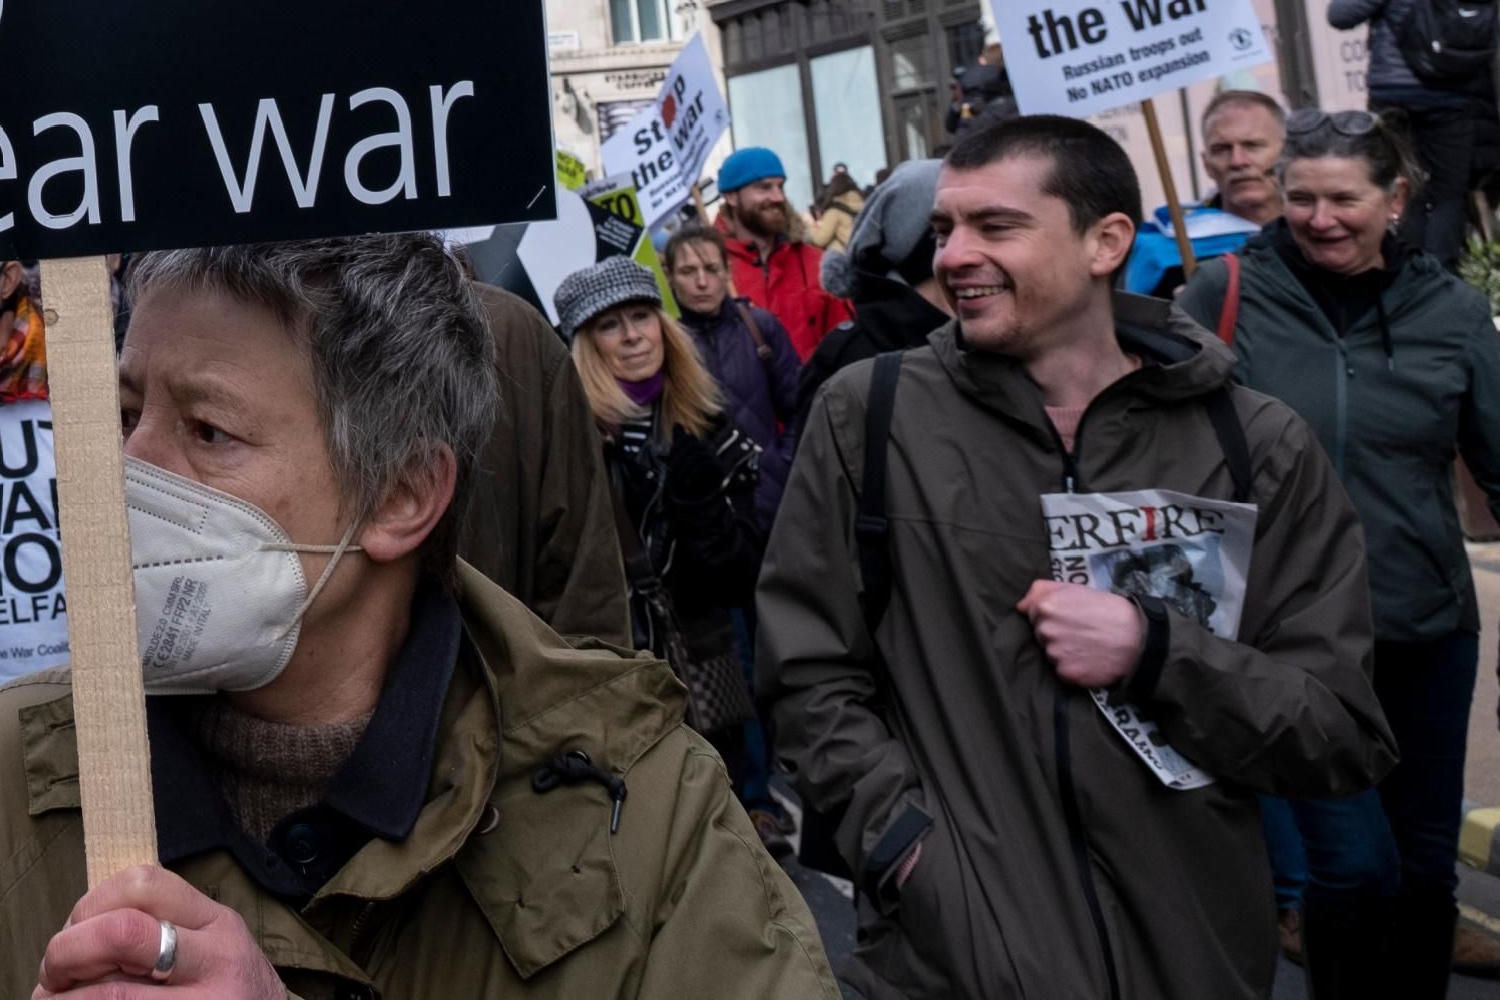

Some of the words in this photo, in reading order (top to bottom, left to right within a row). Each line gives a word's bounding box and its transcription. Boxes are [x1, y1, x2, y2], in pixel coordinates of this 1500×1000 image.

[1026, 7, 1108, 59] the
[1062, 52, 1126, 82] Russian
[1129, 34, 1176, 62] troops
[1180, 27, 1204, 46] out
[1067, 85, 1088, 102] No
[1091, 74, 1134, 97] NATO
[1138, 50, 1211, 83] expansion
[198, 80, 474, 214] war
[631, 150, 674, 192] the
[673, 90, 704, 150] war
[1045, 504, 1225, 550] ERFIRE
[171, 597, 192, 627] FFP2
[182, 578, 199, 598] NR
[10, 646, 34, 659] War
[37, 642, 69, 657] Coali
